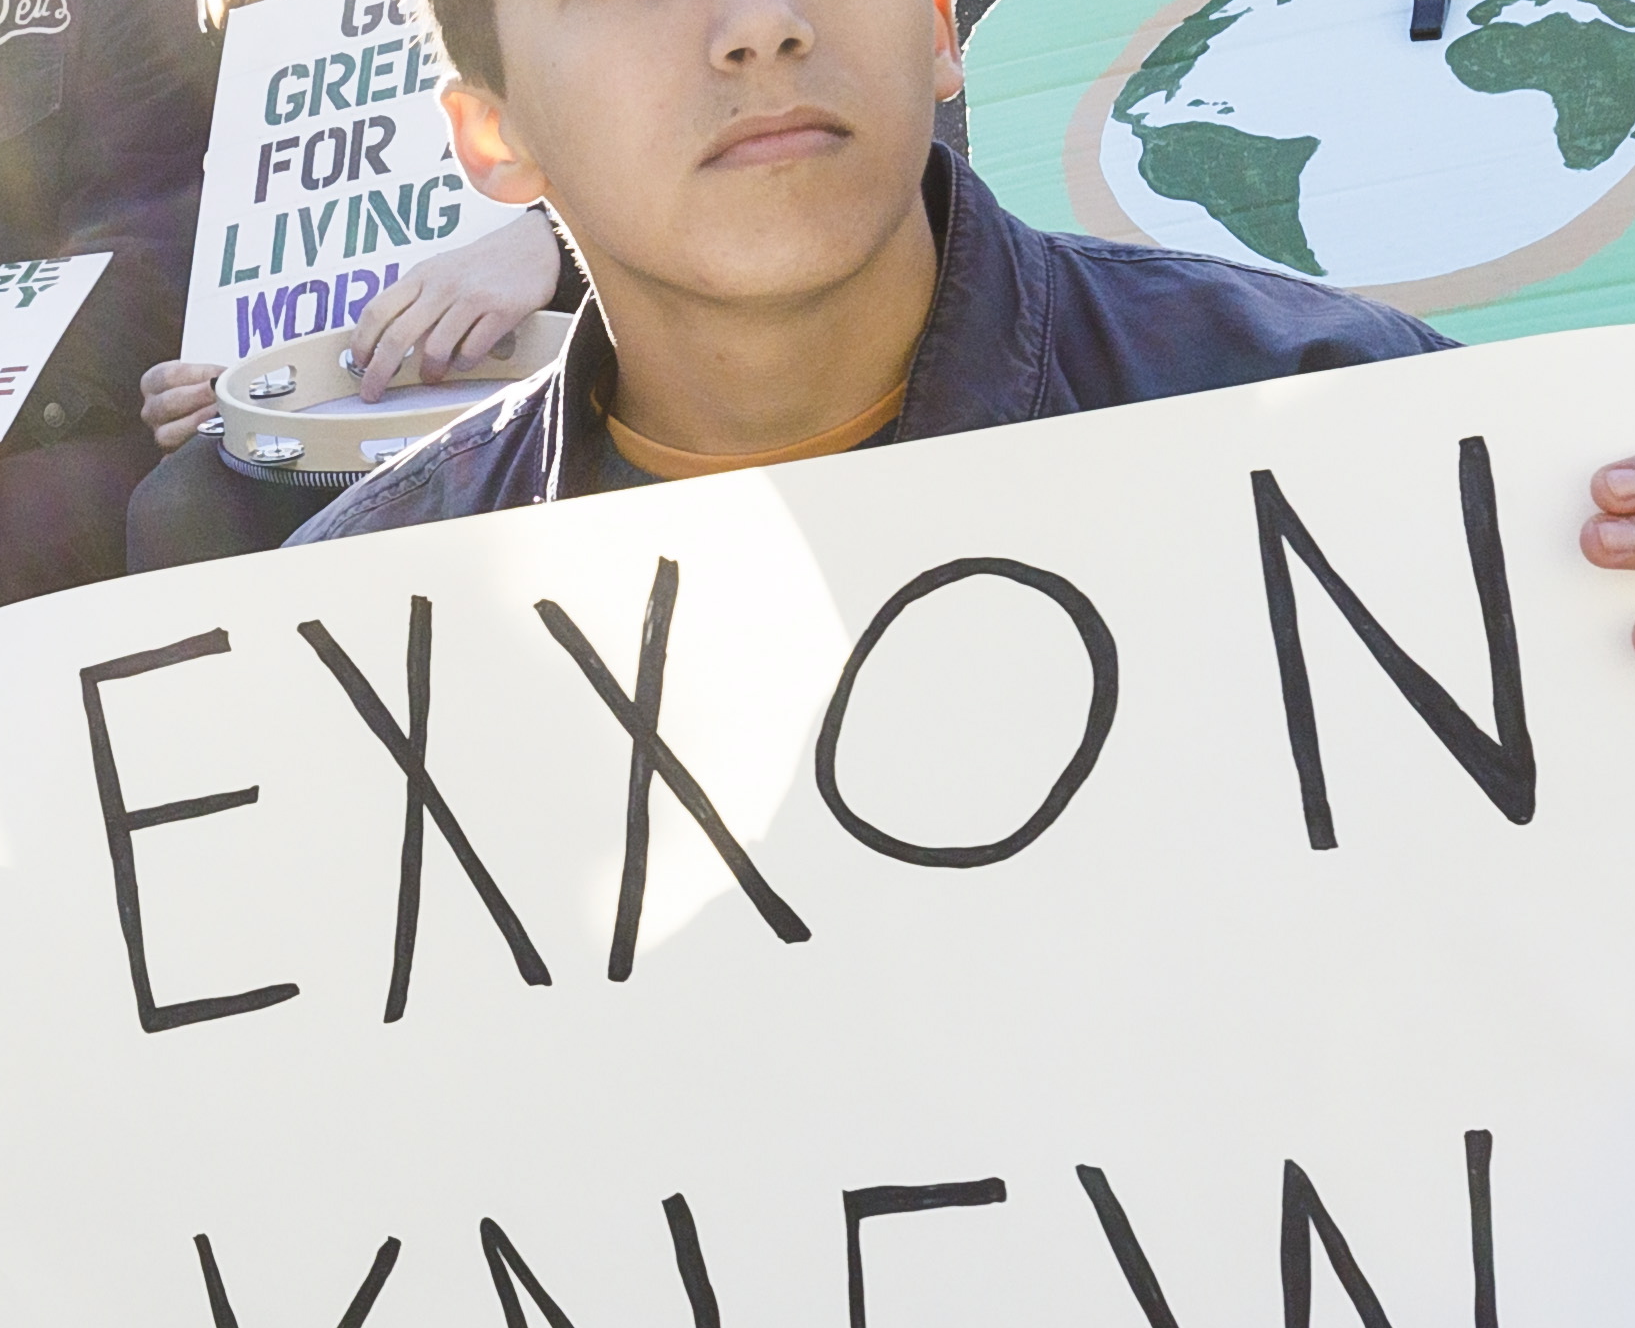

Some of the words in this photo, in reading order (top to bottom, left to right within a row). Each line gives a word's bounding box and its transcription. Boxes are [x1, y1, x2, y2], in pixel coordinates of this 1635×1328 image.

[264, 33, 442, 126] GREE
[253, 114, 397, 204] FOR
[217, 173, 464, 288] LIVING
[235, 261, 402, 359] WOR
[79, 435, 1537, 1033] EXXON
